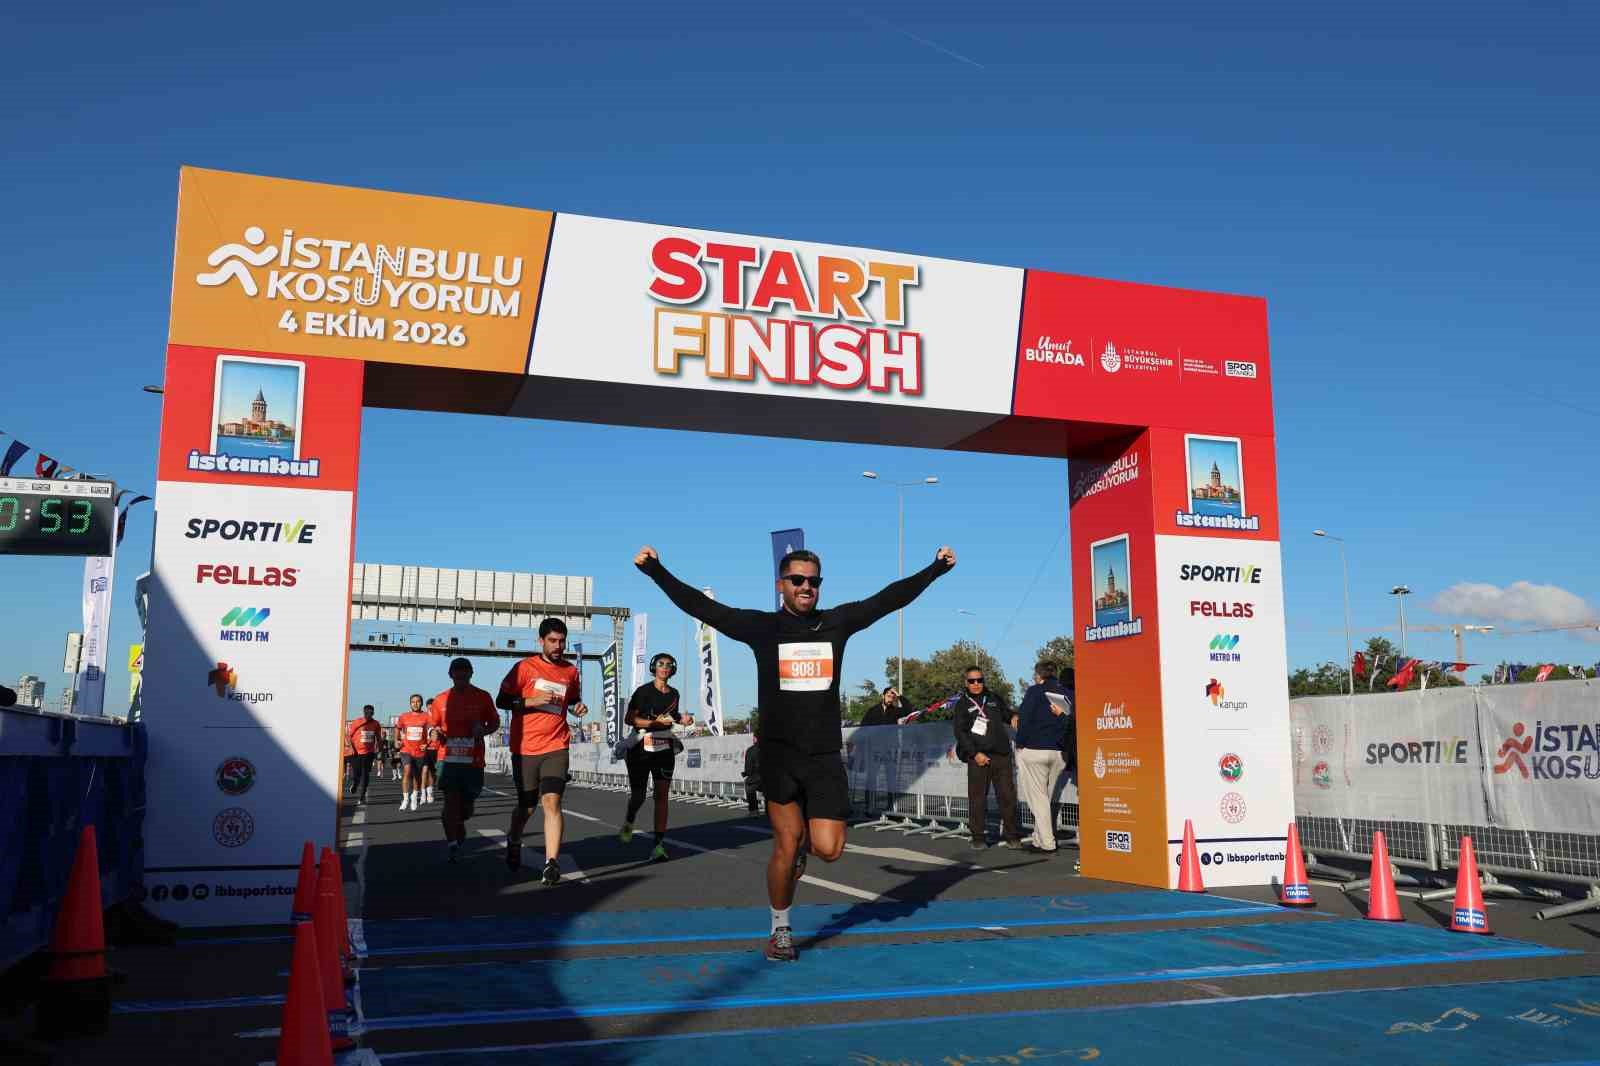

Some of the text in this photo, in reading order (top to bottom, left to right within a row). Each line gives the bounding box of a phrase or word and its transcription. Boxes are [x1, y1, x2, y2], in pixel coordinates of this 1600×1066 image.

[648, 237, 918, 324] START
[278, 309, 467, 347] 4 EKİM 2026
[655, 306, 922, 395] FINISH
[1025, 349, 1085, 366] BURADA
[1226, 362, 1254, 371] SPOR
[187, 450, 319, 478] istanbul
[1175, 509, 1260, 530] istanbul
[185, 519, 316, 544] SPORTIVE
[1180, 564, 1261, 584] SPORTIVE
[220, 630, 270, 642] METRO FM
[1209, 653, 1241, 662] METRO FM
[791, 661, 822, 678] 9081
[228, 688, 273, 704] kanyon
[1219, 699, 1248, 712] kanyon
[1096, 716, 1133, 730] BURADA
[1366, 737, 1468, 765] SPORTIVE
[1227, 851, 1286, 864] ibbsporistanb
